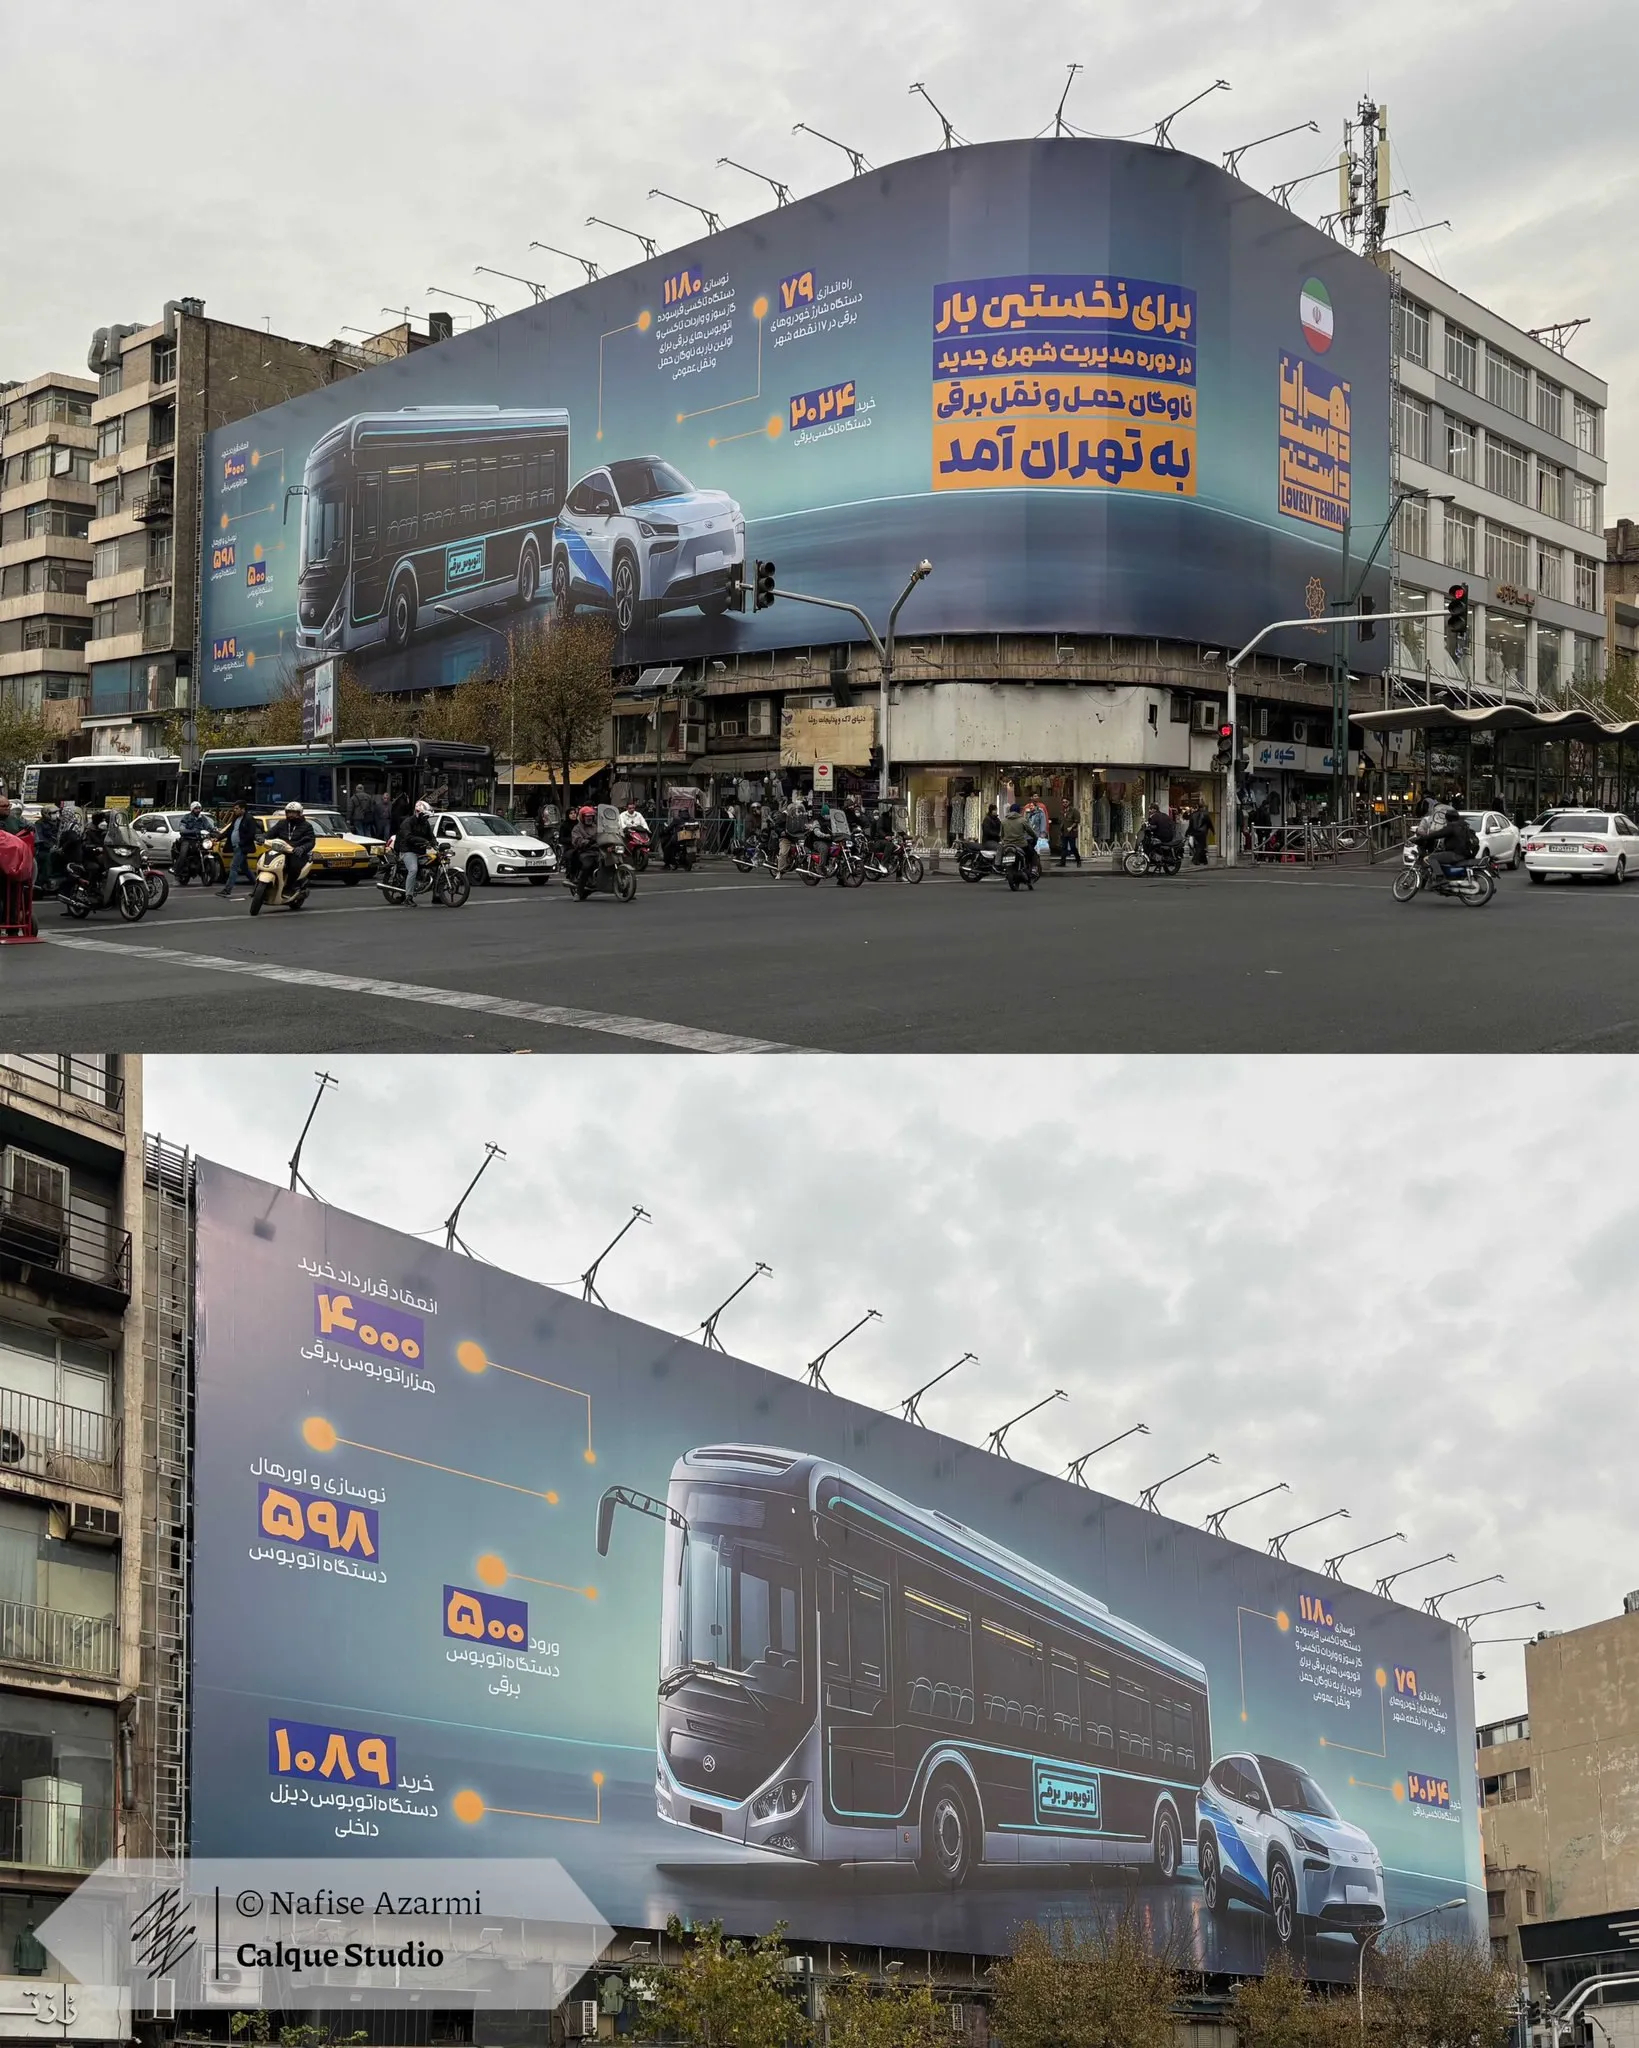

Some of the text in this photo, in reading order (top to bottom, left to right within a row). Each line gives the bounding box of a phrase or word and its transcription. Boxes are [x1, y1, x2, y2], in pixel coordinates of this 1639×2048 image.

[664, 272, 729, 304] نوسازی ۱۱۸۰
[781, 271, 813, 308] ۷۹
[657, 288, 735, 322] دستگاه تاکسی فرسوده
[770, 293, 863, 332] دستگاه شارژ خودروهای
[838, 311, 857, 328] برقی
[935, 280, 1192, 340] برای نخستین بار
[659, 319, 732, 354] اتوبوس های برقی برای
[773, 331, 792, 348] شهر
[793, 322, 817, 339] نقطه
[828, 319, 836, 331] در
[657, 356, 673, 369] حمل
[672, 364, 696, 380] عمومی
[938, 341, 1192, 376] در دوره مدیریت شهری جدید
[791, 382, 876, 428] خرید ۲۰۲۴
[936, 381, 987, 420] برقی
[1063, 385, 1125, 412] حمل
[1128, 390, 1192, 421] ناوگان
[794, 417, 872, 446] دستگاه تاکسی برقی
[939, 424, 1190, 491] به تهران آمد
[1281, 484, 1348, 526] LOVELY TEHRAN
[213, 547, 234, 569] ۵۹۸
[248, 566, 265, 586] ۵۰۰
[214, 638, 235, 660] ۱۰۸۹
[1260, 744, 1295, 765] کوه نور
[298, 1257, 337, 1280] خرید
[389, 1288, 438, 1315] انعقاد
[318, 1294, 421, 1359] ۴۰۰۰
[300, 1339, 436, 1393] هزار اتوبوس برقی
[250, 1457, 386, 1504] نوسازی و اورهال
[262, 1488, 376, 1557] ۵۹۸
[249, 1547, 387, 1584] دستگاه اتوبوس
[447, 1590, 560, 1656] ورود ۵۰۰
[1300, 1594, 1333, 1626] ۱۱۸۰
[446, 1649, 560, 1677] دستگاه اتوبوس
[488, 1675, 521, 1699] برقی
[1394, 1667, 1417, 1696] ۷۹
[275, 1728, 434, 1793] خرید ۱۰۸۹
[270, 1784, 438, 1818] دستگاه اتوبوس دیزل
[1040, 1781, 1094, 1808] اتوبوس برقی
[1408, 1775, 1449, 1804] ۲۰۲۴
[335, 1819, 379, 1837] داخلی
